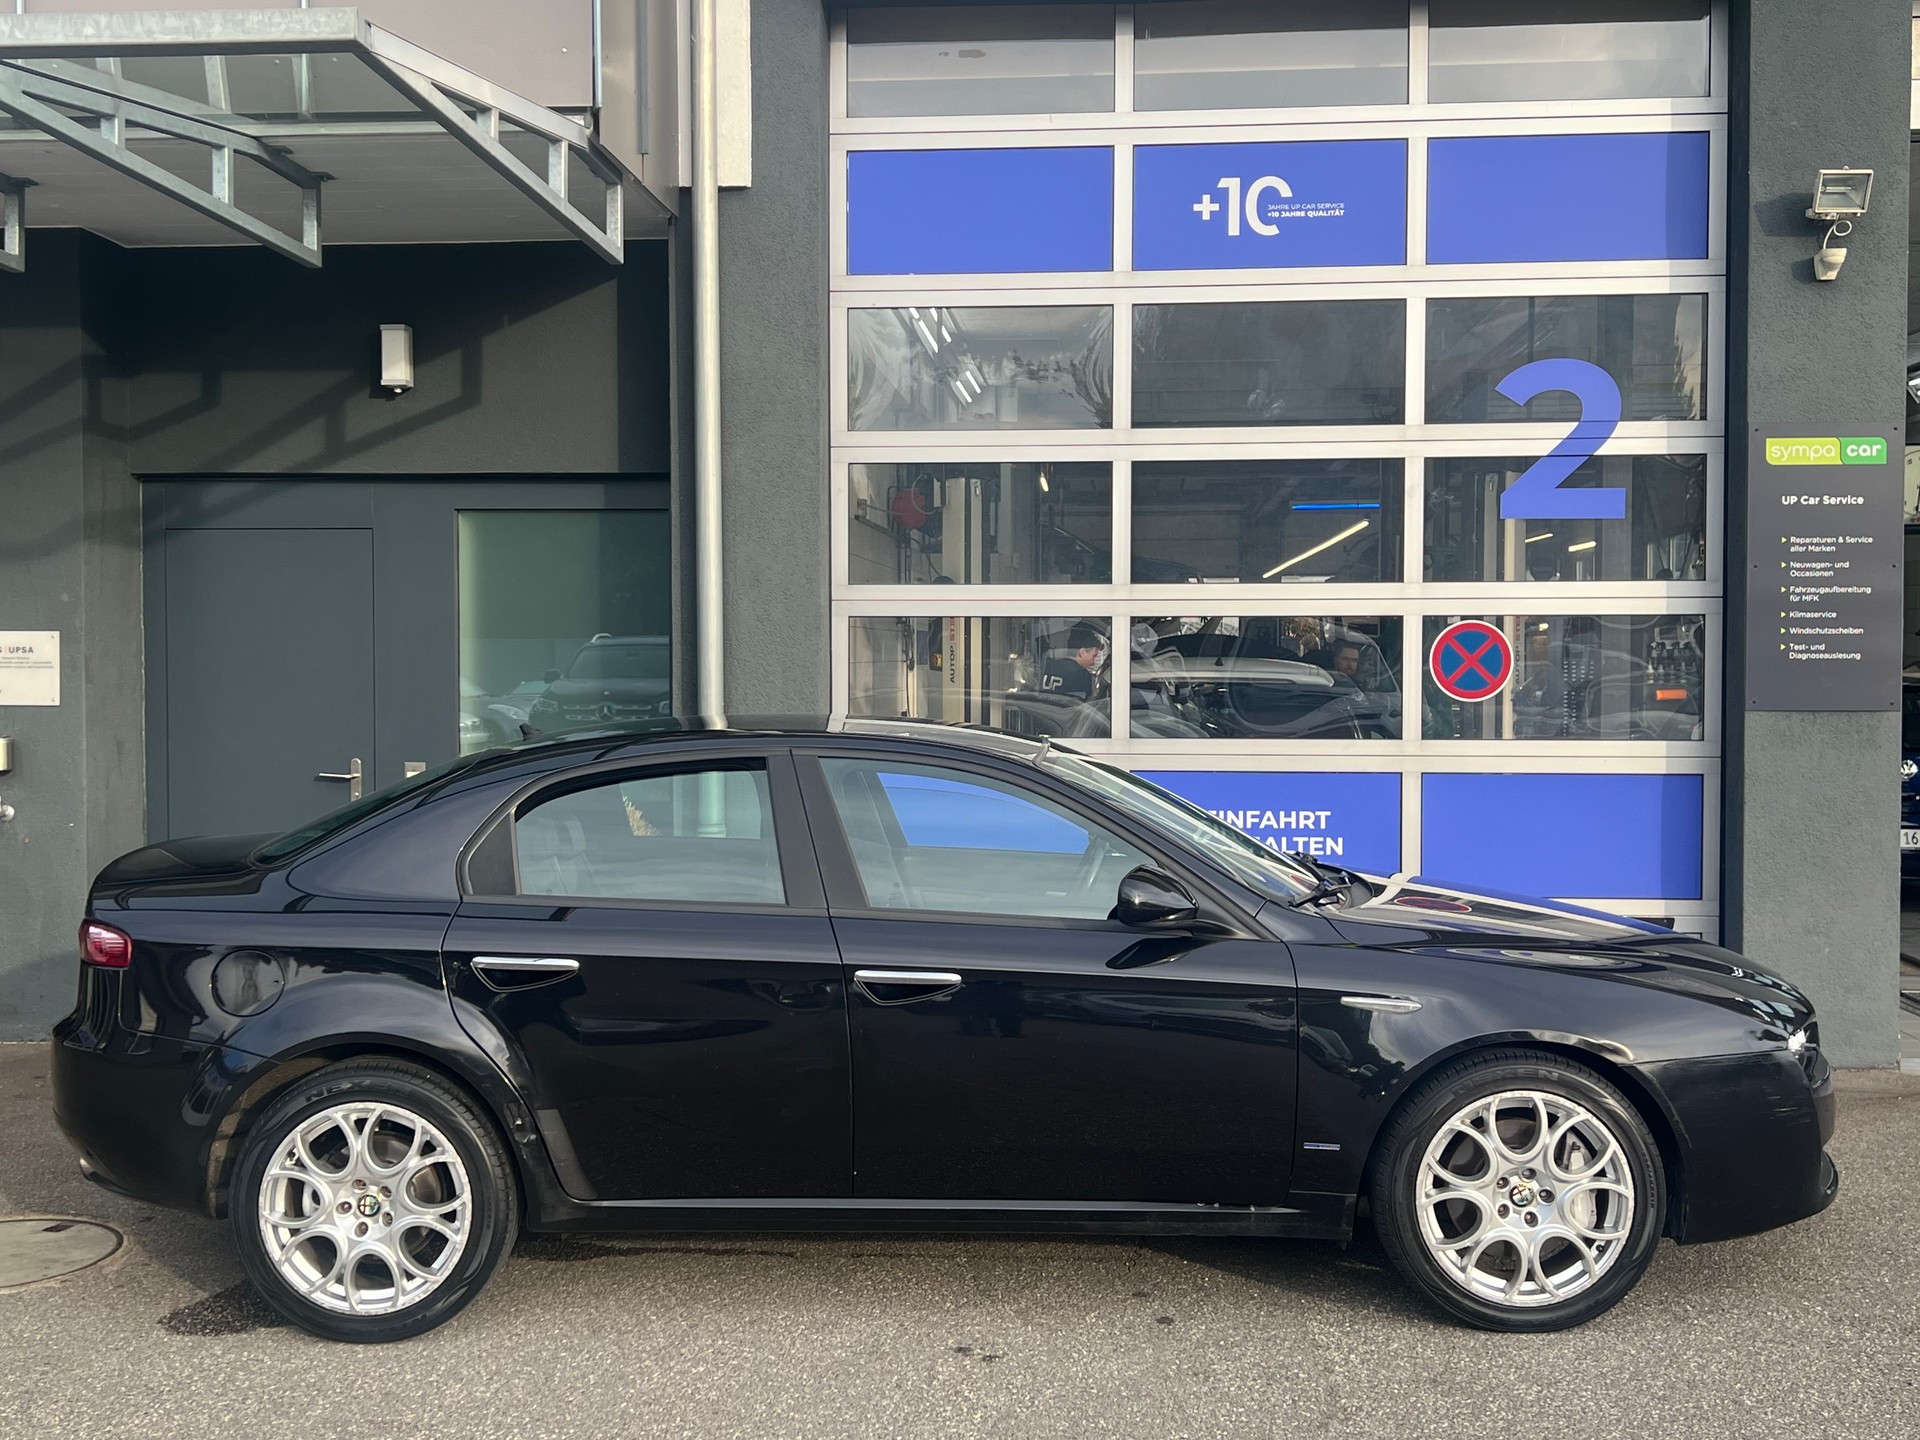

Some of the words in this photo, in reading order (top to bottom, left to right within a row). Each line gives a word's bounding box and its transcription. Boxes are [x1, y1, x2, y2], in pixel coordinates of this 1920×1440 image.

[1307, 209, 1345, 218] QUALITÄT
[1495, 357, 1626, 520] 2
[1771, 444, 1835, 461] sympa
[1846, 444, 1882, 457] car
[1781, 495, 1798, 505] UP
[1800, 495, 1820, 505] Car
[1822, 494, 1865, 505] Service
[1790, 536, 1836, 545] Reparaturen
[1838, 536, 1844, 544] &
[1845, 536, 1873, 544] Service
[1790, 561, 1833, 569] Neuwagen-
[1834, 560, 1850, 568] und
[1789, 585, 1872, 595] Fahrzeugaufbereitung
[1789, 594, 1801, 602] für
[1802, 594, 1820, 602] MFK
[8, 646, 34, 654] UPSA
[1789, 652, 1861, 660] Diagnoseauslesung
[1042, 674, 1063, 691] UP
[1254, 836, 1343, 856] ALTEN
